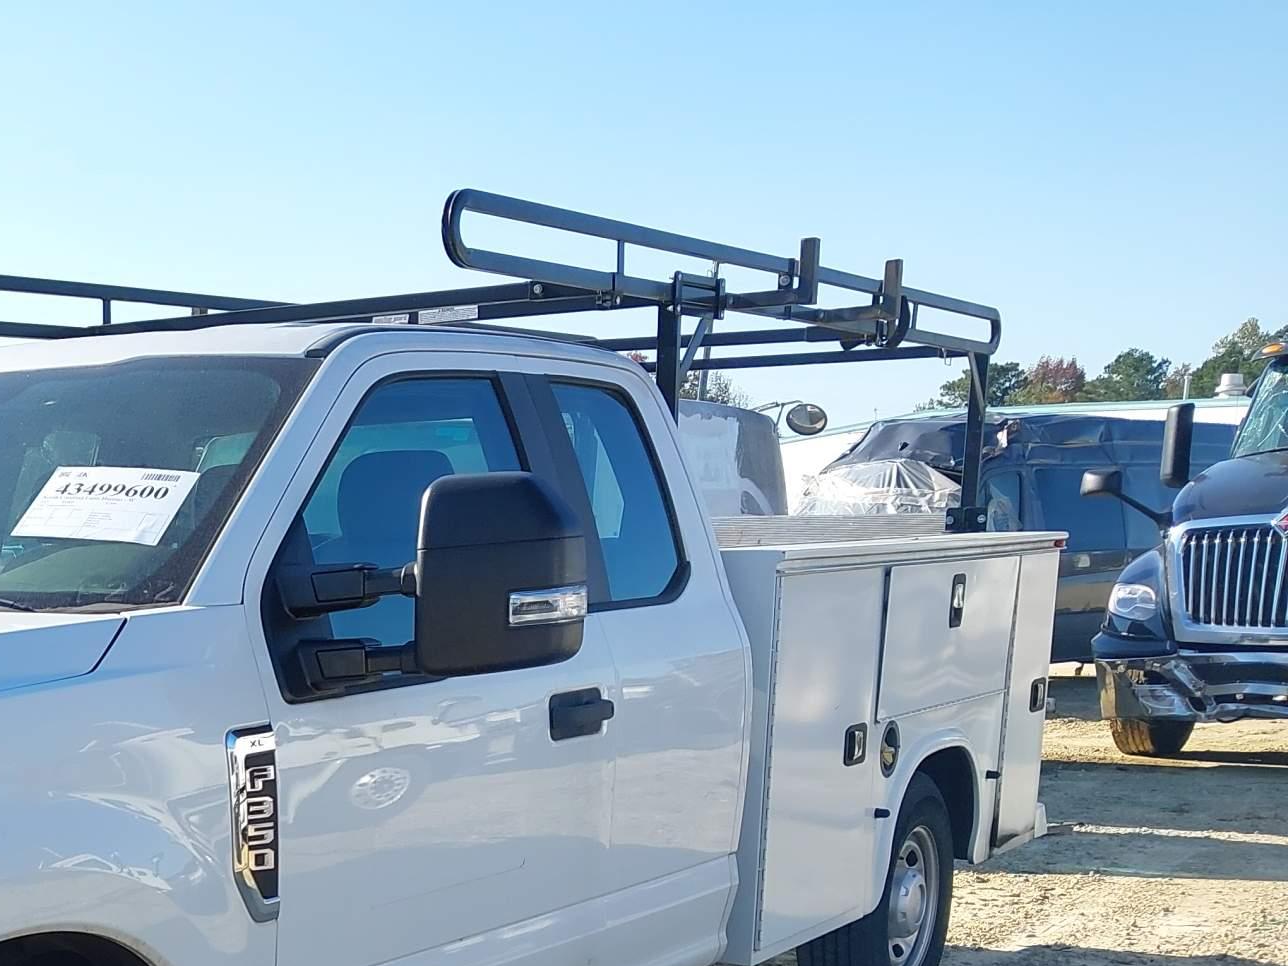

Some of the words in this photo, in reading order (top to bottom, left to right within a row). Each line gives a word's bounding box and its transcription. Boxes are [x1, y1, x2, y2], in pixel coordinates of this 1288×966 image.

[55, 482, 169, 500] 43499600
[249, 739, 264, 748] XL
[246, 765, 275, 871] F350
